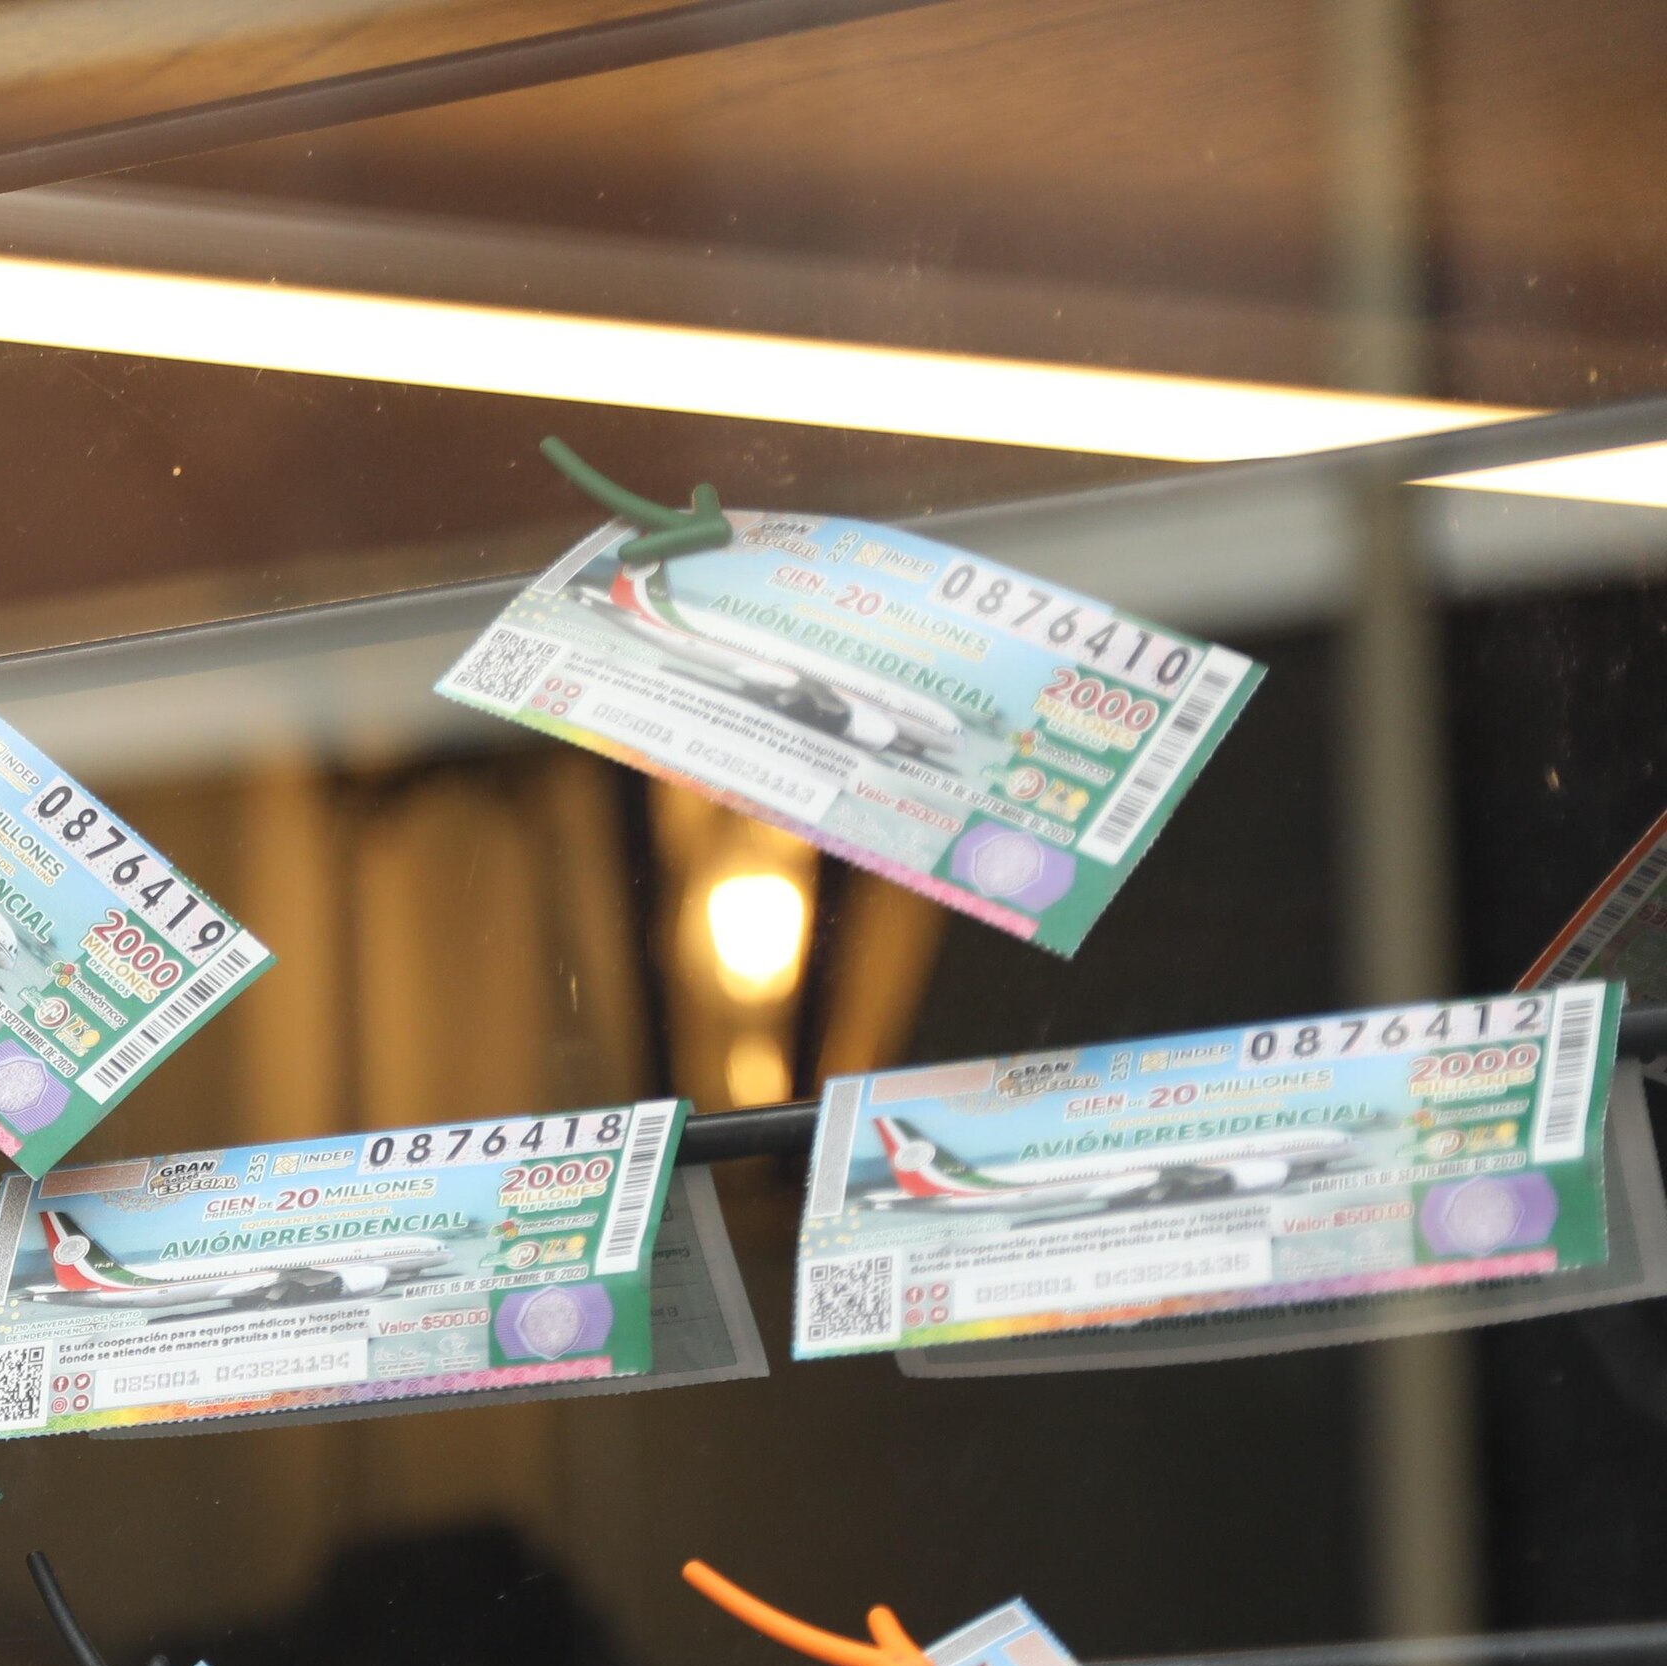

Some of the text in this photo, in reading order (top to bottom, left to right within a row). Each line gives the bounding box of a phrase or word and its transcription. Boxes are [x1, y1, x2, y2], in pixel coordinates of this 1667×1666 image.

[833, 583, 882, 617] 20
[941, 563, 1193, 688] 0876410
[708, 591, 993, 717] AVIÓN PRESIDENCIAL
[1043, 668, 1157, 732] 2000
[36, 784, 226, 952] 0876419
[81, 935, 160, 1005] MILLONES
[93, 911, 180, 989] 2000
[1251, 998, 1541, 1063] 0876412
[1412, 1045, 1539, 1082] 2000
[1151, 1086, 1198, 1110] 20
[368, 1119, 622, 1168] 0876418
[1021, 1105, 1376, 1163] AVIÓN PRESIDENCIAL
[206, 1176, 434, 1214] CIEN 20 MILLONES
[500, 1160, 613, 1192] 2000
[500, 1183, 607, 1205] MILLONES
[160, 1211, 464, 1259] AVIÓN PRESIDENCIAL
